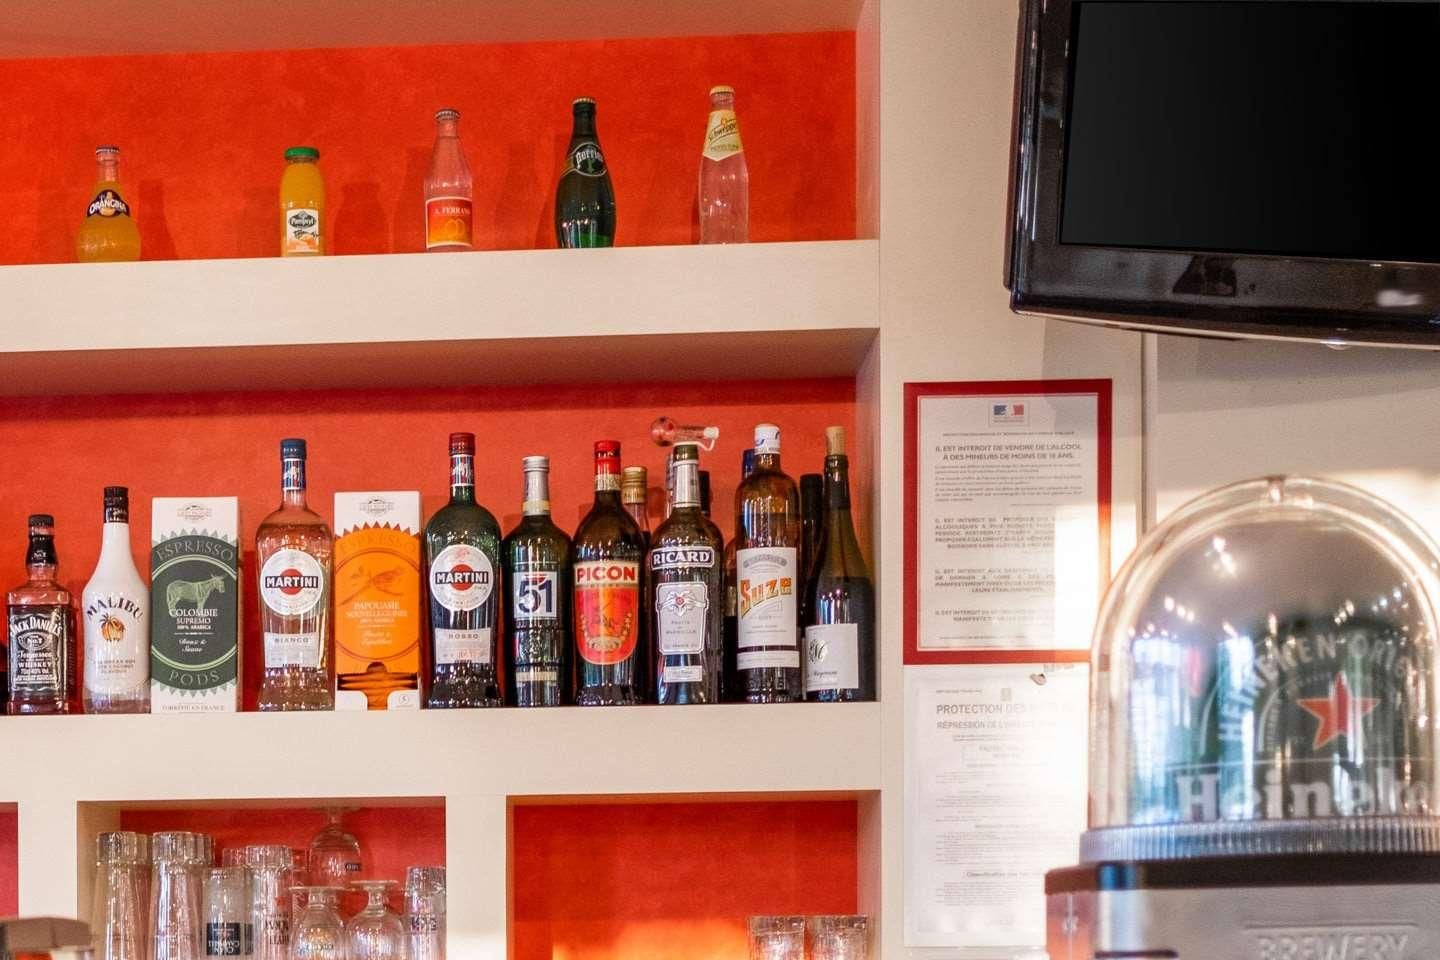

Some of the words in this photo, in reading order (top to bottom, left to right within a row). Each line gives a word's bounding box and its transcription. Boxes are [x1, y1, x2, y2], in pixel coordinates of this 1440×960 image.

[155, 540, 234, 561] ESPRESSO
[653, 550, 711, 566] RICARD
[434, 571, 489, 585] MARTINI
[575, 562, 636, 585] PICON
[265, 576, 318, 588] MARTINI
[517, 581, 553, 614] 51
[87, 597, 143, 620] MALIBU
[169, 608, 219, 618] COLOMBIE
[9, 619, 30, 637] JACK
[176, 617, 211, 625] SUPREMO
[169, 670, 221, 686] PODS
[936, 703, 1003, 714] PROTECTION
